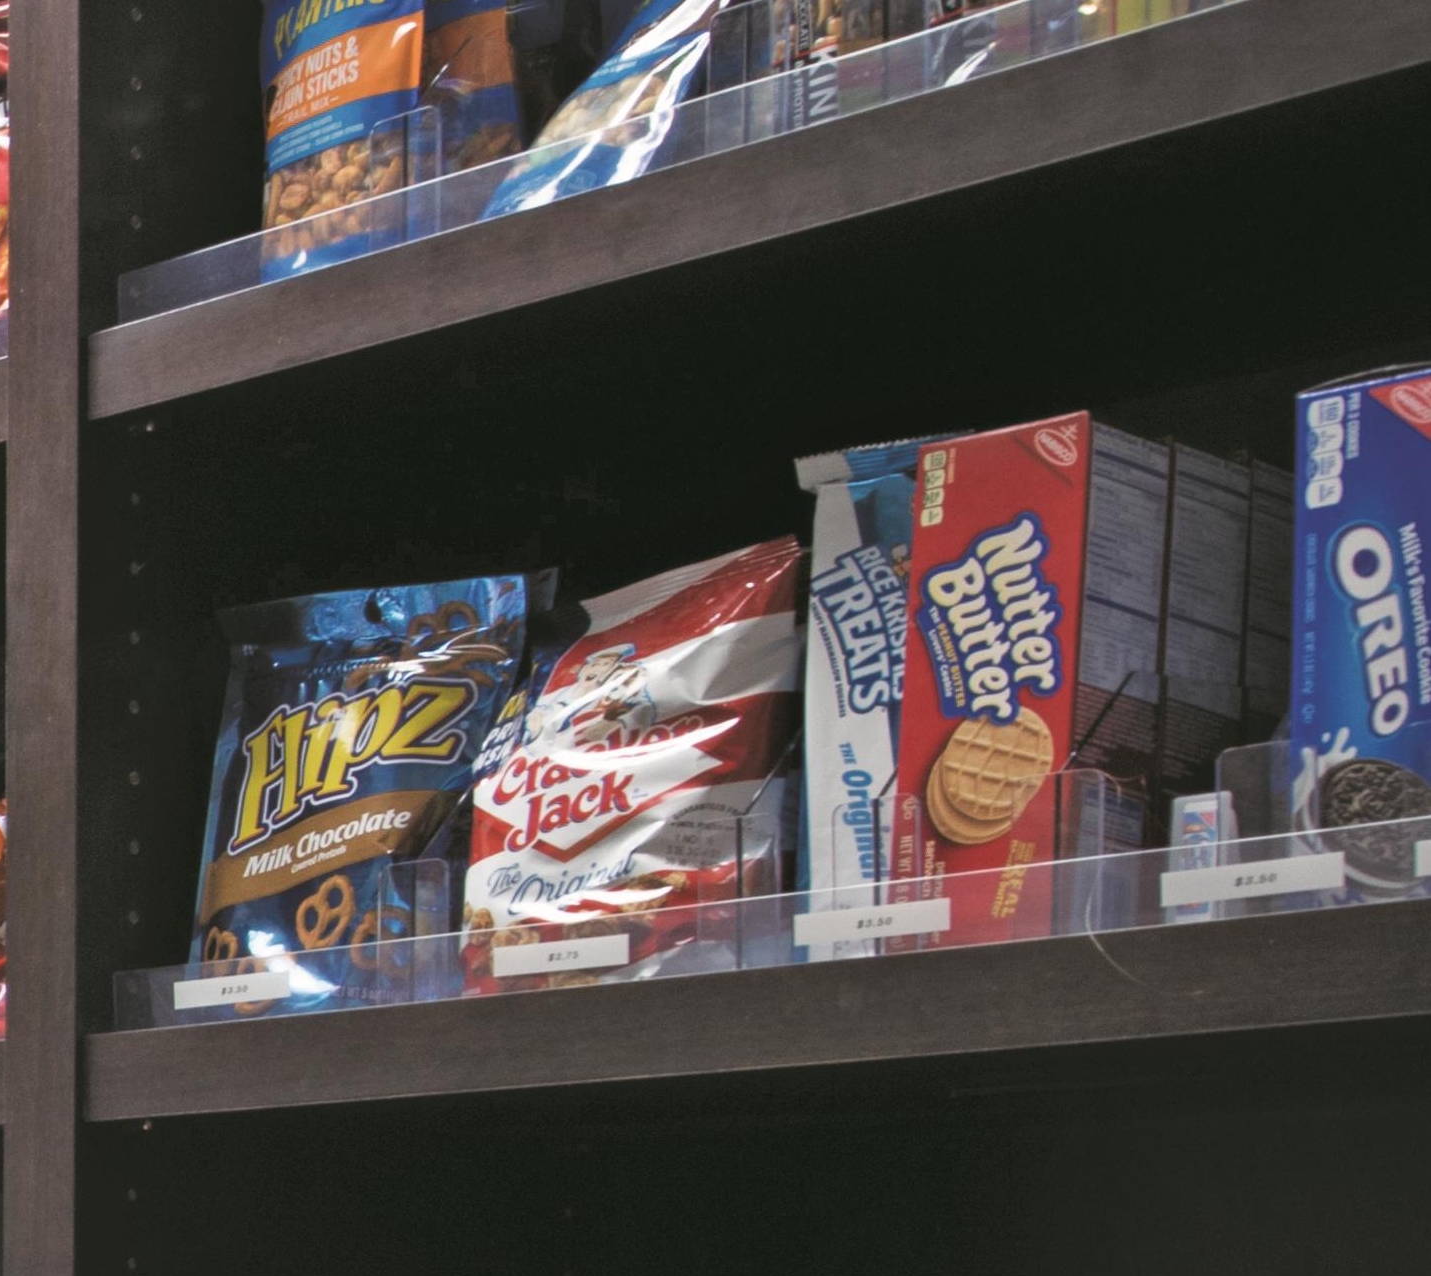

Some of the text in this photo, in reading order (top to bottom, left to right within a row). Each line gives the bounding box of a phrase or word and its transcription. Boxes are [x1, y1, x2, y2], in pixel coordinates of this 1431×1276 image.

[305, 42, 343, 71] NUTS
[306, 60, 359, 101] STICKS
[857, 544, 893, 600] RICE
[974, 517, 1058, 694] Nutter
[1401, 564, 1429, 651] Favorite
[810, 552, 890, 714] TREATS
[925, 559, 1014, 723] Butter
[1335, 525, 1410, 737] OREO
[229, 678, 478, 854] Flipz
[838, 741, 858, 765] THE
[242, 808, 411, 878] Milk Chocolate
[506, 769, 633, 852] Jack
[841, 769, 877, 881] Original
[1234, 872, 1278, 888] $3.50
